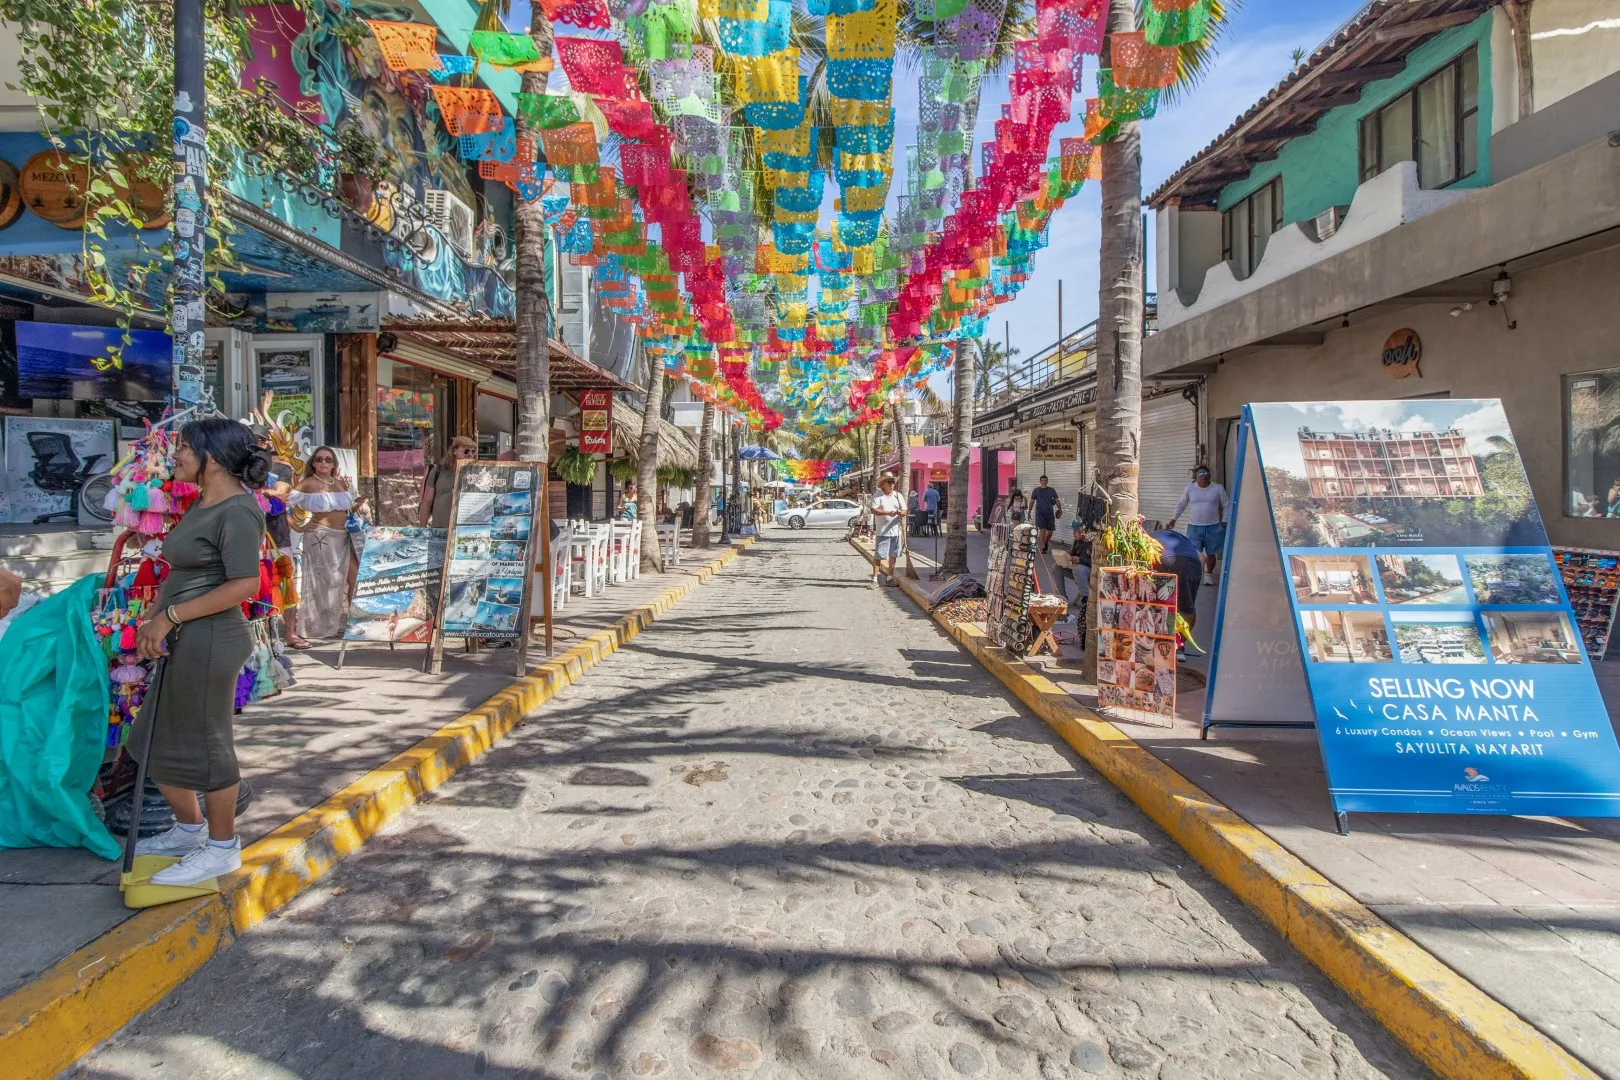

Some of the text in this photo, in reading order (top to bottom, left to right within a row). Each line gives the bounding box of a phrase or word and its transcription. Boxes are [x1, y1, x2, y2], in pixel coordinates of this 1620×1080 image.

[32, 172, 79, 184] MEZCAL
[1368, 677, 1535, 699] SELLING NOW
[1382, 703, 1540, 722] CASA MANTA
[1335, 727, 1599, 739] 6 Luxury Condos Ocean Views Pool Gym
[1395, 741, 1544, 756] SAYULITA NAYARIT
